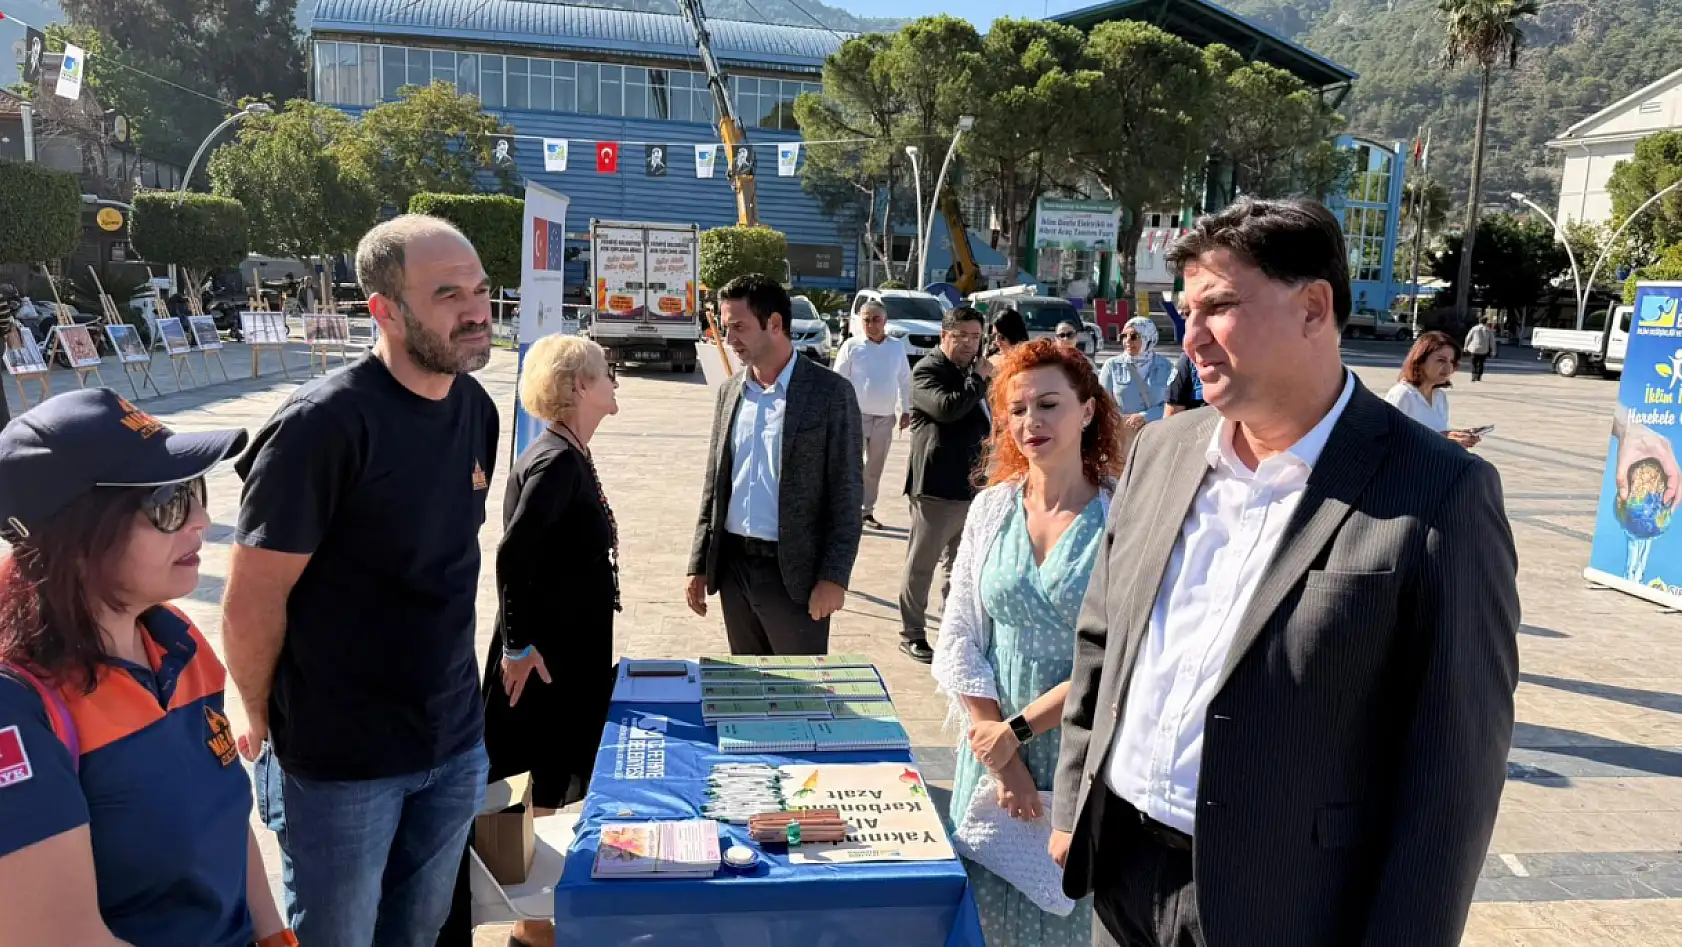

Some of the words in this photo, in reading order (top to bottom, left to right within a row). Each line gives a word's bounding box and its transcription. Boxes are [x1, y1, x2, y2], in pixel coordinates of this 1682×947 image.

[1644, 383, 1673, 404] İklim
[1627, 407, 1675, 426] Harekete
[825, 790, 883, 800] Azalt
